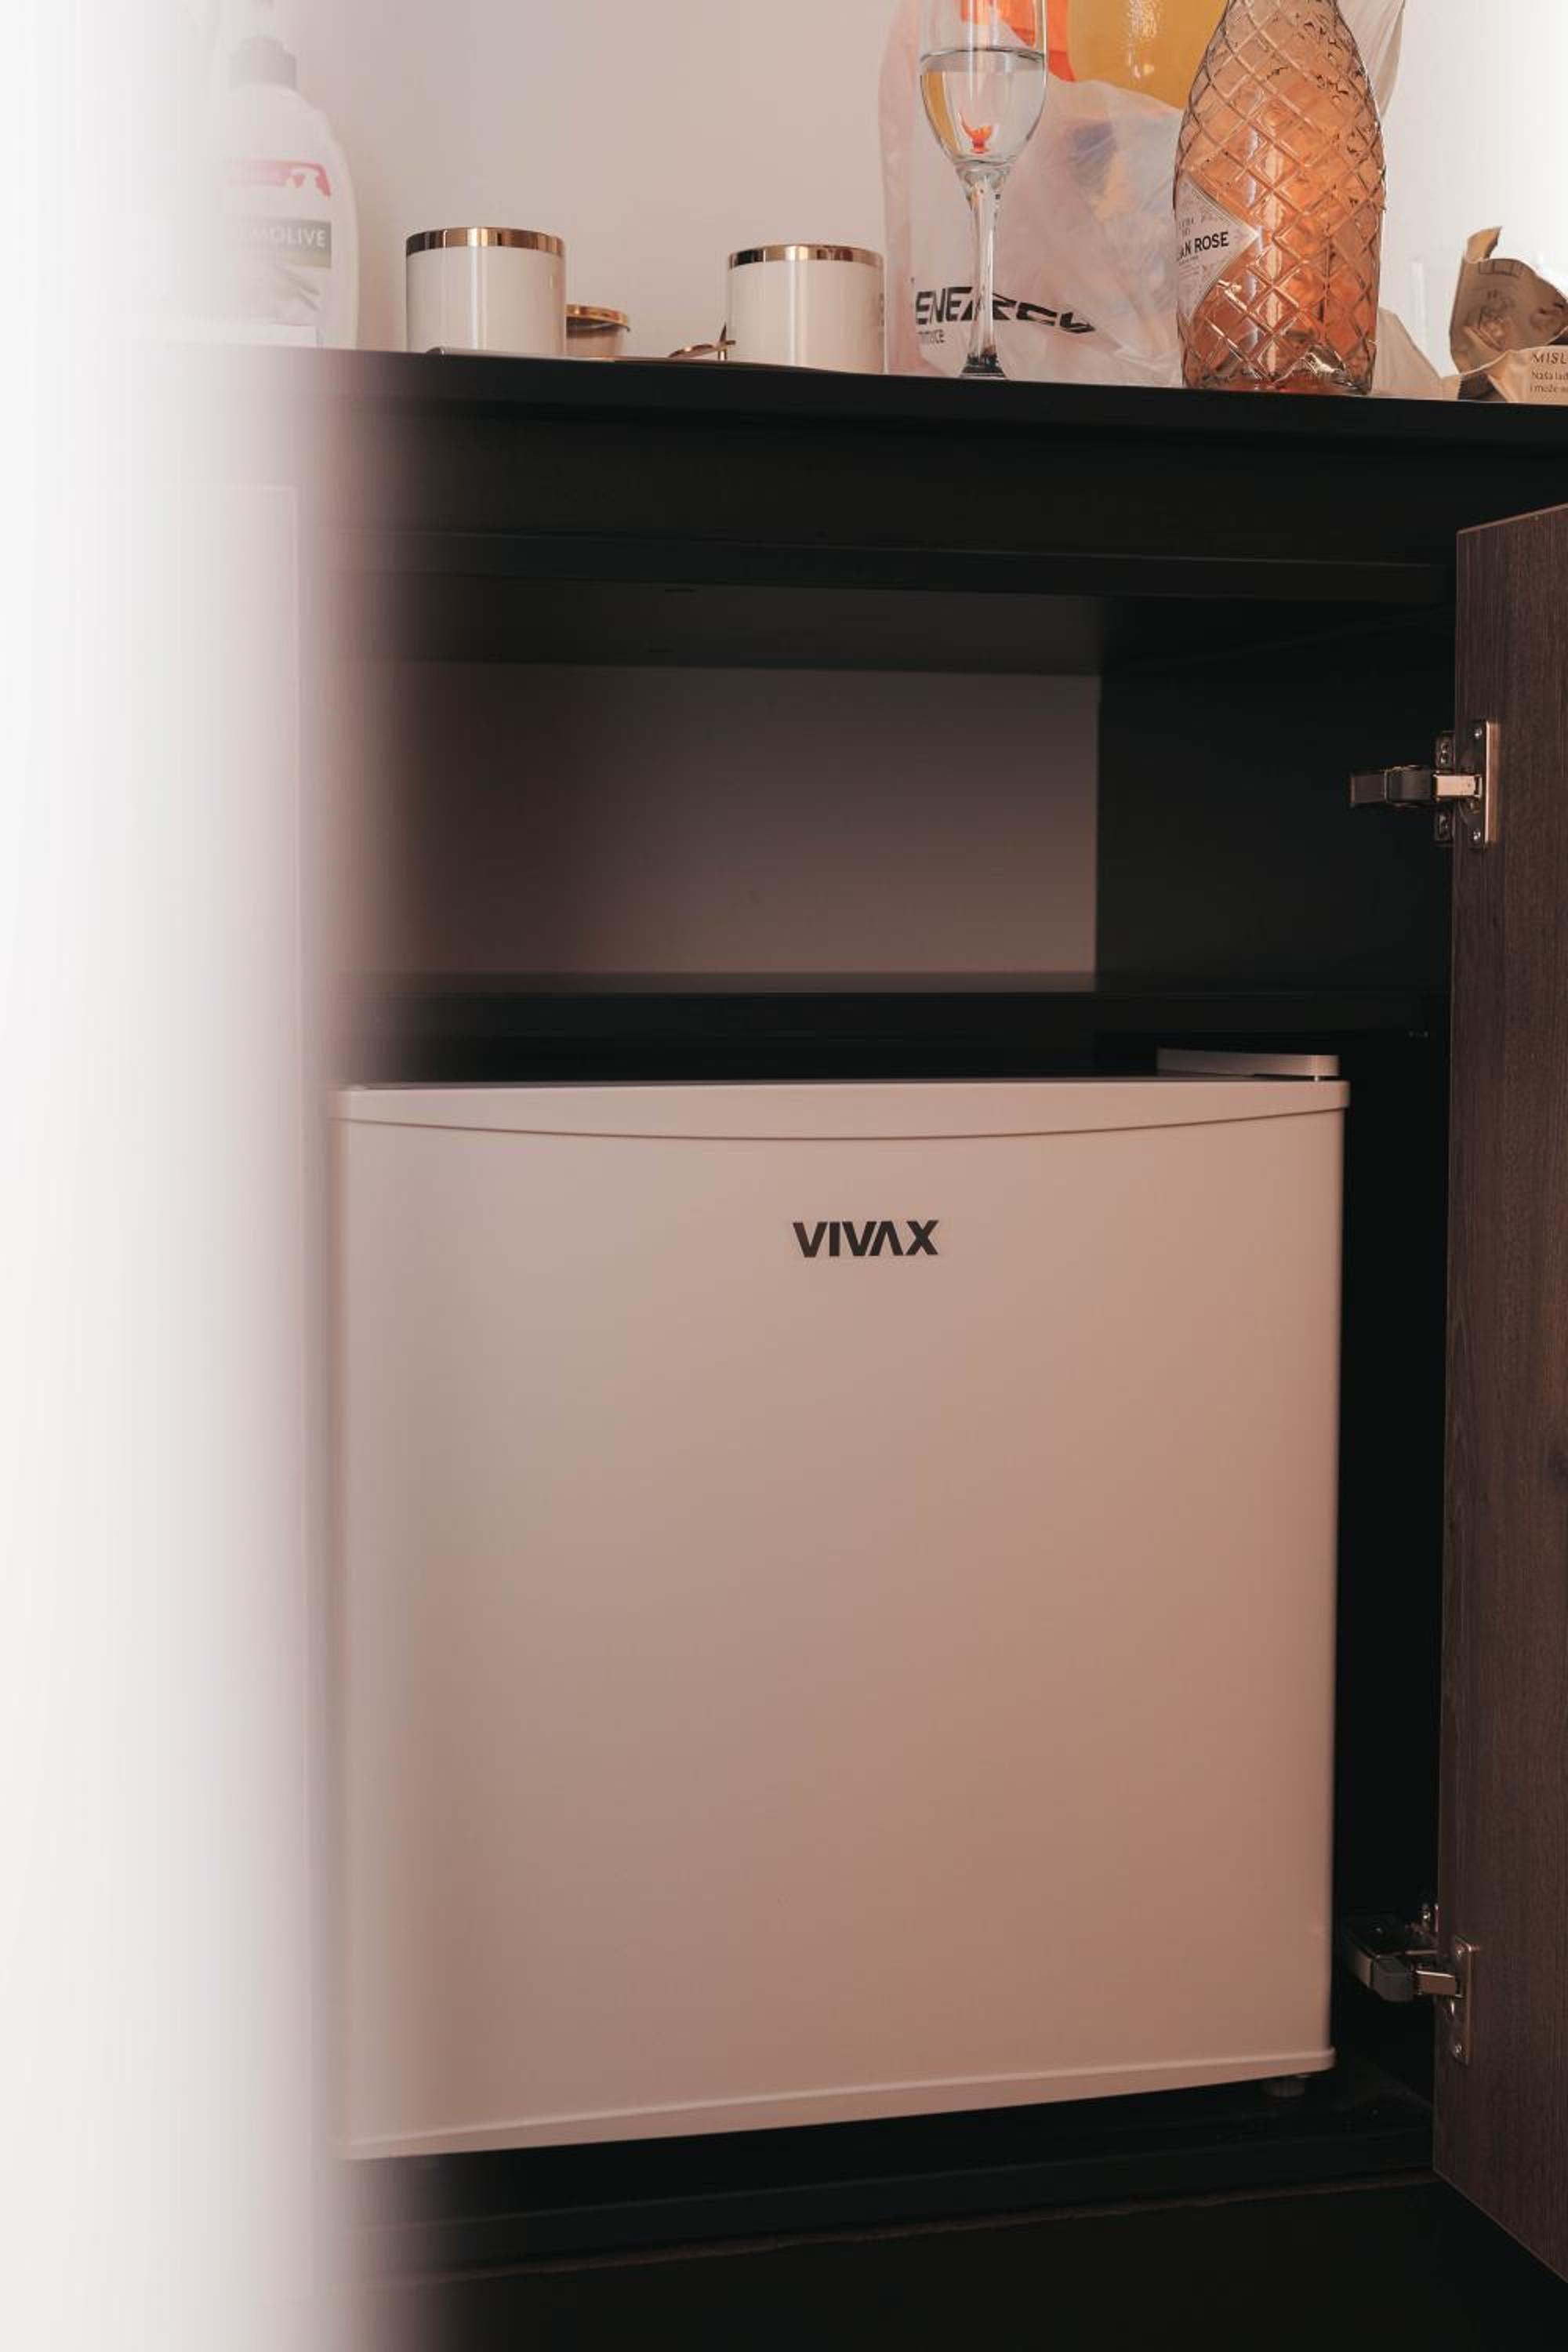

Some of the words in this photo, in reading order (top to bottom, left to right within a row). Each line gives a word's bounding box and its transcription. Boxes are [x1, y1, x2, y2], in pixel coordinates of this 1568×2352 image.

[1177, 239, 1192, 261] AN
[1194, 231, 1230, 253] ROSE
[793, 1220, 939, 1258] VIVAX
